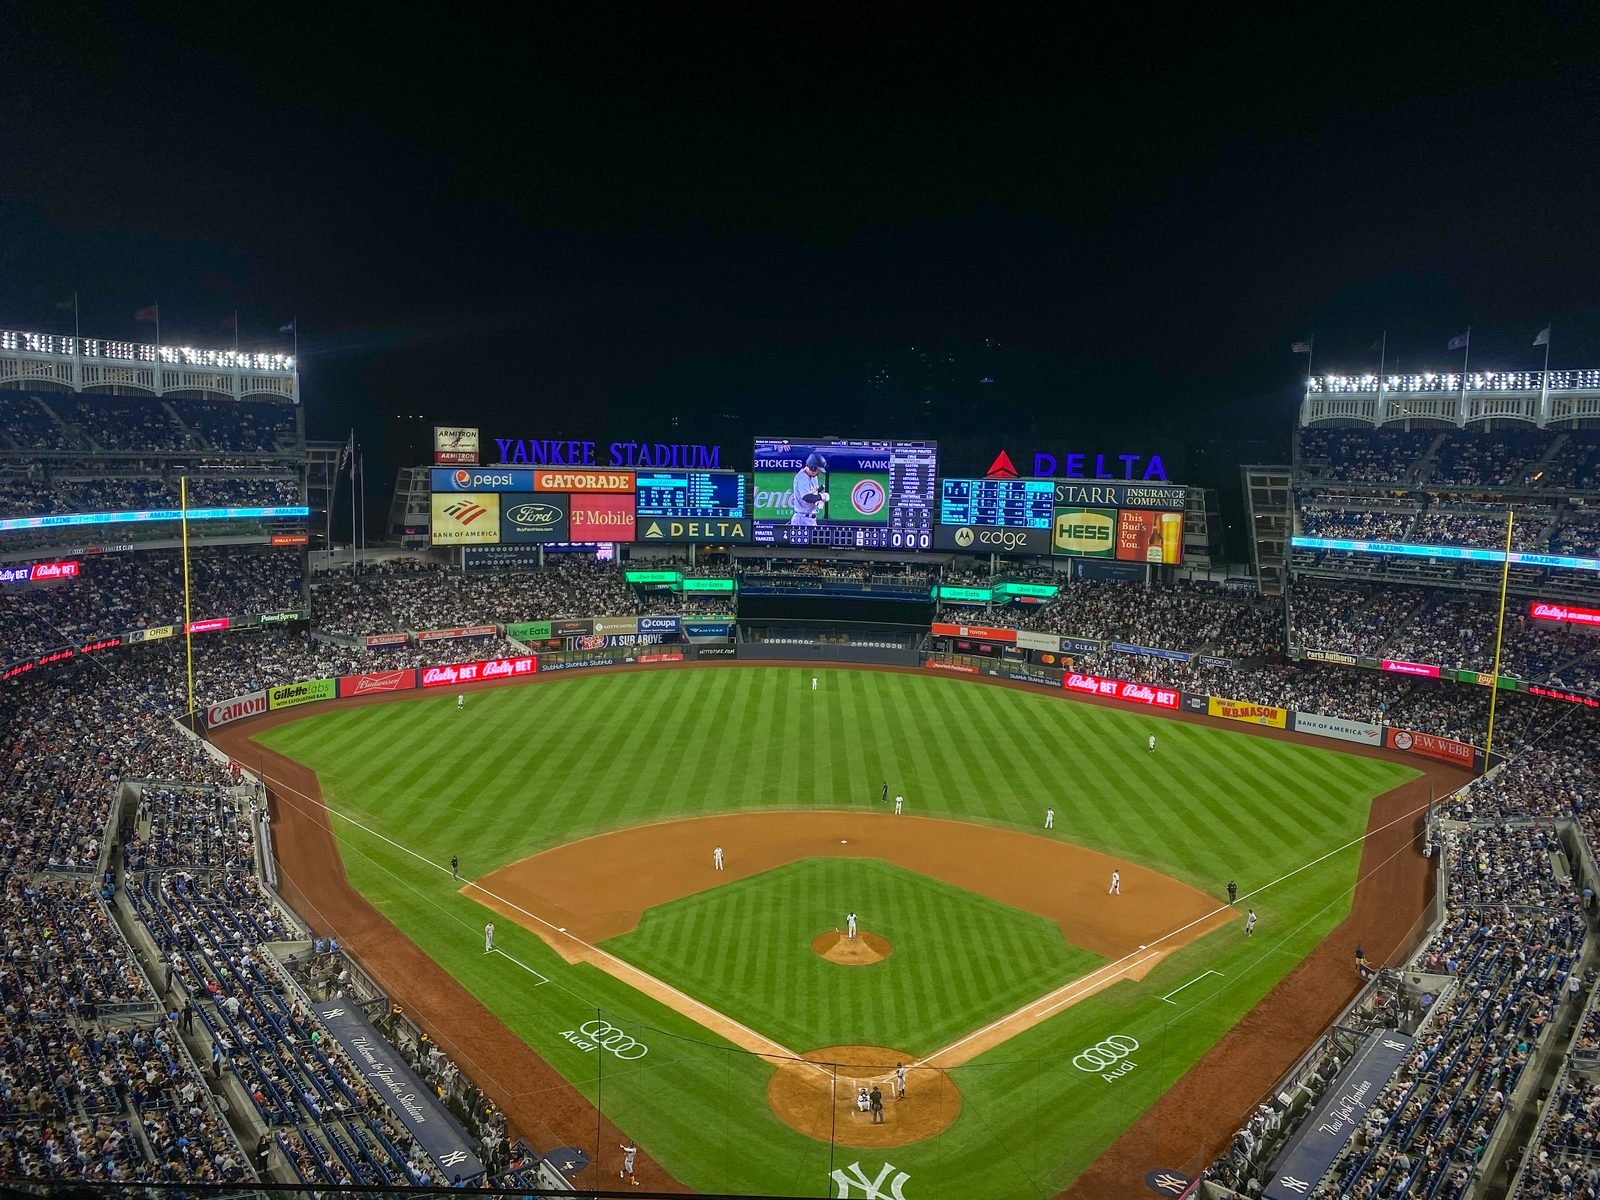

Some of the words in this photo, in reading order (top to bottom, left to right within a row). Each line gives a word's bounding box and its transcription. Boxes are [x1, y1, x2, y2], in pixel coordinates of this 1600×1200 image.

[495, 439, 596, 466] YANKEE
[609, 442, 720, 469] STADIUM
[858, 460, 890, 469] YANK
[1034, 453, 1167, 480] DELTA
[474, 474, 512, 487] pepsi
[541, 475, 629, 489] GATORADE
[1055, 486, 1119, 504] STARR
[1127, 488, 1185, 498] INSURANCE
[1126, 497, 1184, 507] COMPANIES
[517, 506, 553, 522] Ford
[588, 511, 634, 525] Mobile
[1122, 513, 1143, 522] This
[671, 523, 744, 537] DELTA
[1059, 524, 1109, 540] HESS
[1122, 523, 1147, 531] Bud's
[893, 534, 901, 546] 0
[907, 535, 915, 546] 0
[921, 535, 929, 547] 0
[980, 528, 1027, 550] edge
[1121, 531, 1136, 540] For
[1121, 540, 1140, 549] You.
[1368, 543, 1404, 552] AMAZING
[1520, 555, 1560, 564] AMAZING
[16, 570, 28, 578] BET
[37, 565, 60, 577] Bally
[62, 565, 75, 574] BET
[261, 614, 279, 622] Poland
[280, 612, 298, 621] Spring
[1535, 605, 1568, 620] Bally's
[652, 619, 676, 628] coupa
[149, 628, 168, 636] ORIS
[529, 627, 549, 635] Eats
[610, 637, 616, 646] A
[619, 635, 635, 646] SUB
[638, 634, 663, 645] ABOVE
[1075, 643, 1098, 651] CLEAR
[1325, 652, 1356, 663] Authority
[542, 663, 564, 671] StubHub
[590, 659, 613, 667] StubHub
[424, 667, 459, 683] Bally
[460, 666, 477, 679] BET
[483, 660, 519, 675] Bally
[515, 660, 531, 672] BET
[360, 678, 399, 690] Budweiser
[1068, 674, 1099, 694] Bally
[1101, 682, 1117, 695] BET
[1123, 685, 1155, 704] Bally
[1157, 692, 1176, 705] BET
[288, 694, 316, 705] EXFOLIATING
[208, 696, 266, 725] Canon
[1297, 719, 1317, 728] BANK
[1329, 725, 1362, 736] AMERICA
[1414, 735, 1435, 749] F.W.
[1438, 740, 1469, 758] WEBB
[558, 1030, 598, 1052] Audi
[1101, 1060, 1138, 1083] Audi
[351, 1036, 376, 1068] Welcome
[369, 1067, 402, 1093] Yankee
[398, 1093, 426, 1124] Stadium
[1352, 1080, 1372, 1109] Yankees
[1330, 1094, 1355, 1124] York
[1318, 1118, 1343, 1136] New
